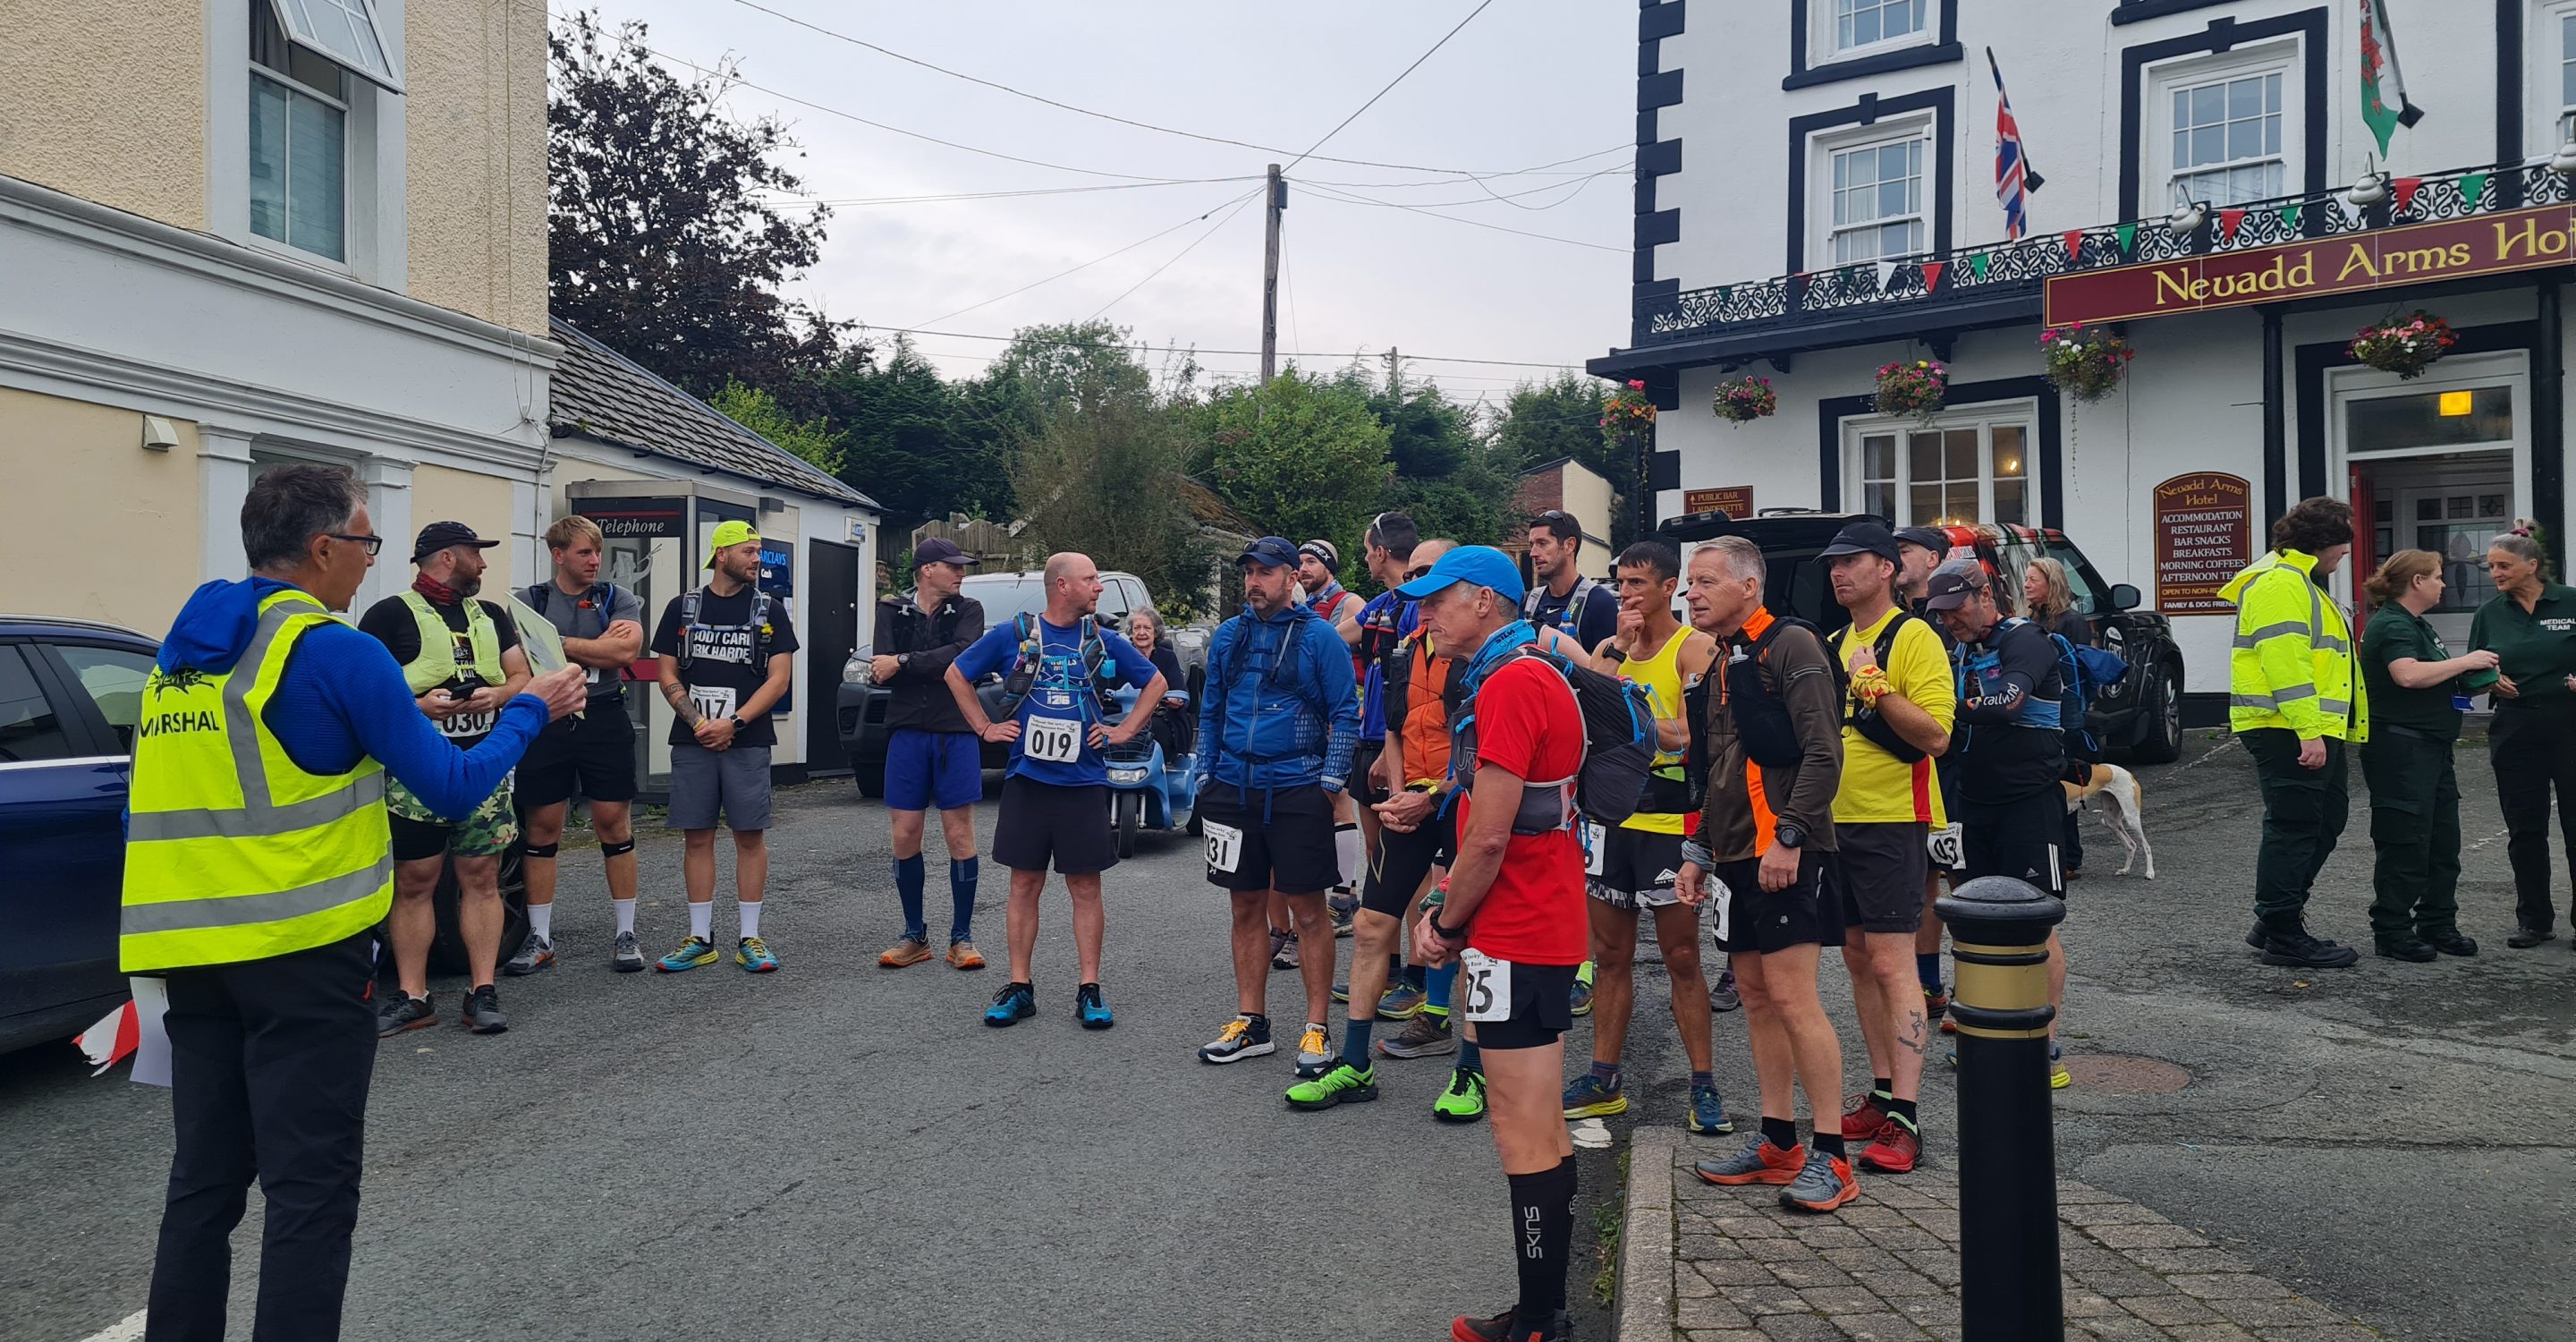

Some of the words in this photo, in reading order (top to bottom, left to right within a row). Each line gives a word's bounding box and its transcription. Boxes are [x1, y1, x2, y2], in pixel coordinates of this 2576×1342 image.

[2335, 242, 2471, 282] Arms
[2209, 478, 2243, 496] Arms
[1698, 493, 1723, 502] PUBLIC
[1723, 491, 1738, 500] BAR
[2186, 493, 2218, 506] Hotel
[2161, 510, 2243, 524] ACCOMMODATION
[596, 518, 665, 536] Telephone
[2171, 522, 2234, 535] RESTAURANT
[2174, 537, 2193, 547] BAR
[2194, 535, 2231, 546] SNACKS
[2173, 547, 2233, 558] BREAKFASTS
[2160, 560, 2204, 571] MORNING
[2205, 558, 2246, 569] COFFEES
[760, 568, 773, 579] Cash
[2161, 572, 2218, 582] AFTERNOON
[2219, 571, 2239, 581] TE
[2162, 588, 2181, 596] OPEN
[2191, 587, 2221, 595] NON-RE
[2164, 601, 2188, 609] FAMILY
[2188, 600, 2195, 608] &
[2195, 600, 2211, 608] DOG
[2212, 600, 2238, 608] FRIEN
[2539, 618, 2576, 626] MEDICAL
[711, 646, 750, 660] HARDE
[694, 697, 727, 720] 017
[140, 709, 221, 738] MARSHAL
[442, 712, 487, 734] 030
[1031, 729, 1072, 758] 019
[1204, 833, 1228, 867] 031
[1523, 1205, 1543, 1260] SKINS
